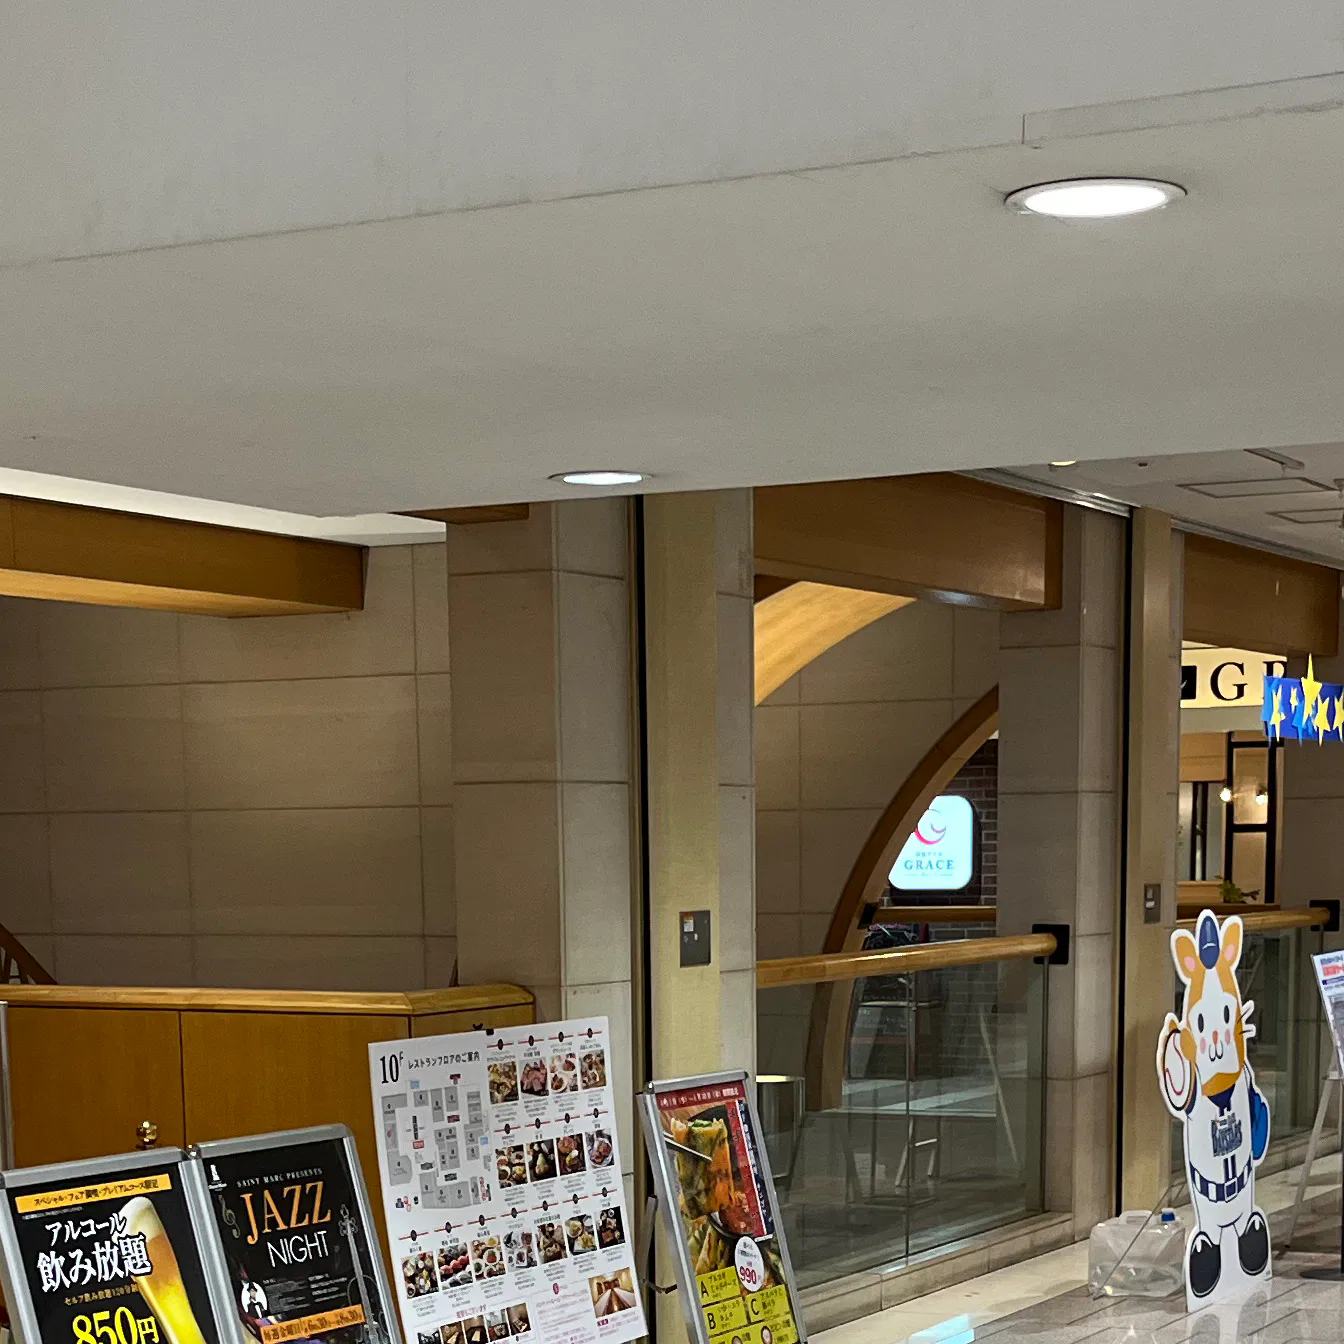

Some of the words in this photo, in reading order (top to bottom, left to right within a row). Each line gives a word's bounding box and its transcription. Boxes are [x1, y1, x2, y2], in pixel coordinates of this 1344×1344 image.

[904, 860, 954, 870] GRACE
[237, 1177, 260, 1188] SAINT
[263, 1174, 284, 1185] MARC
[240, 1181, 331, 1244] JAZZ
[45, 1213, 126, 1246] アルコール
[267, 1230, 329, 1267] NIGHT
[37, 1234, 152, 1293] 飲み放題
[739, 1265, 757, 1284] 990
[700, 1281, 709, 1298] A
[750, 1299, 759, 1315] C
[707, 1313, 716, 1330] B
